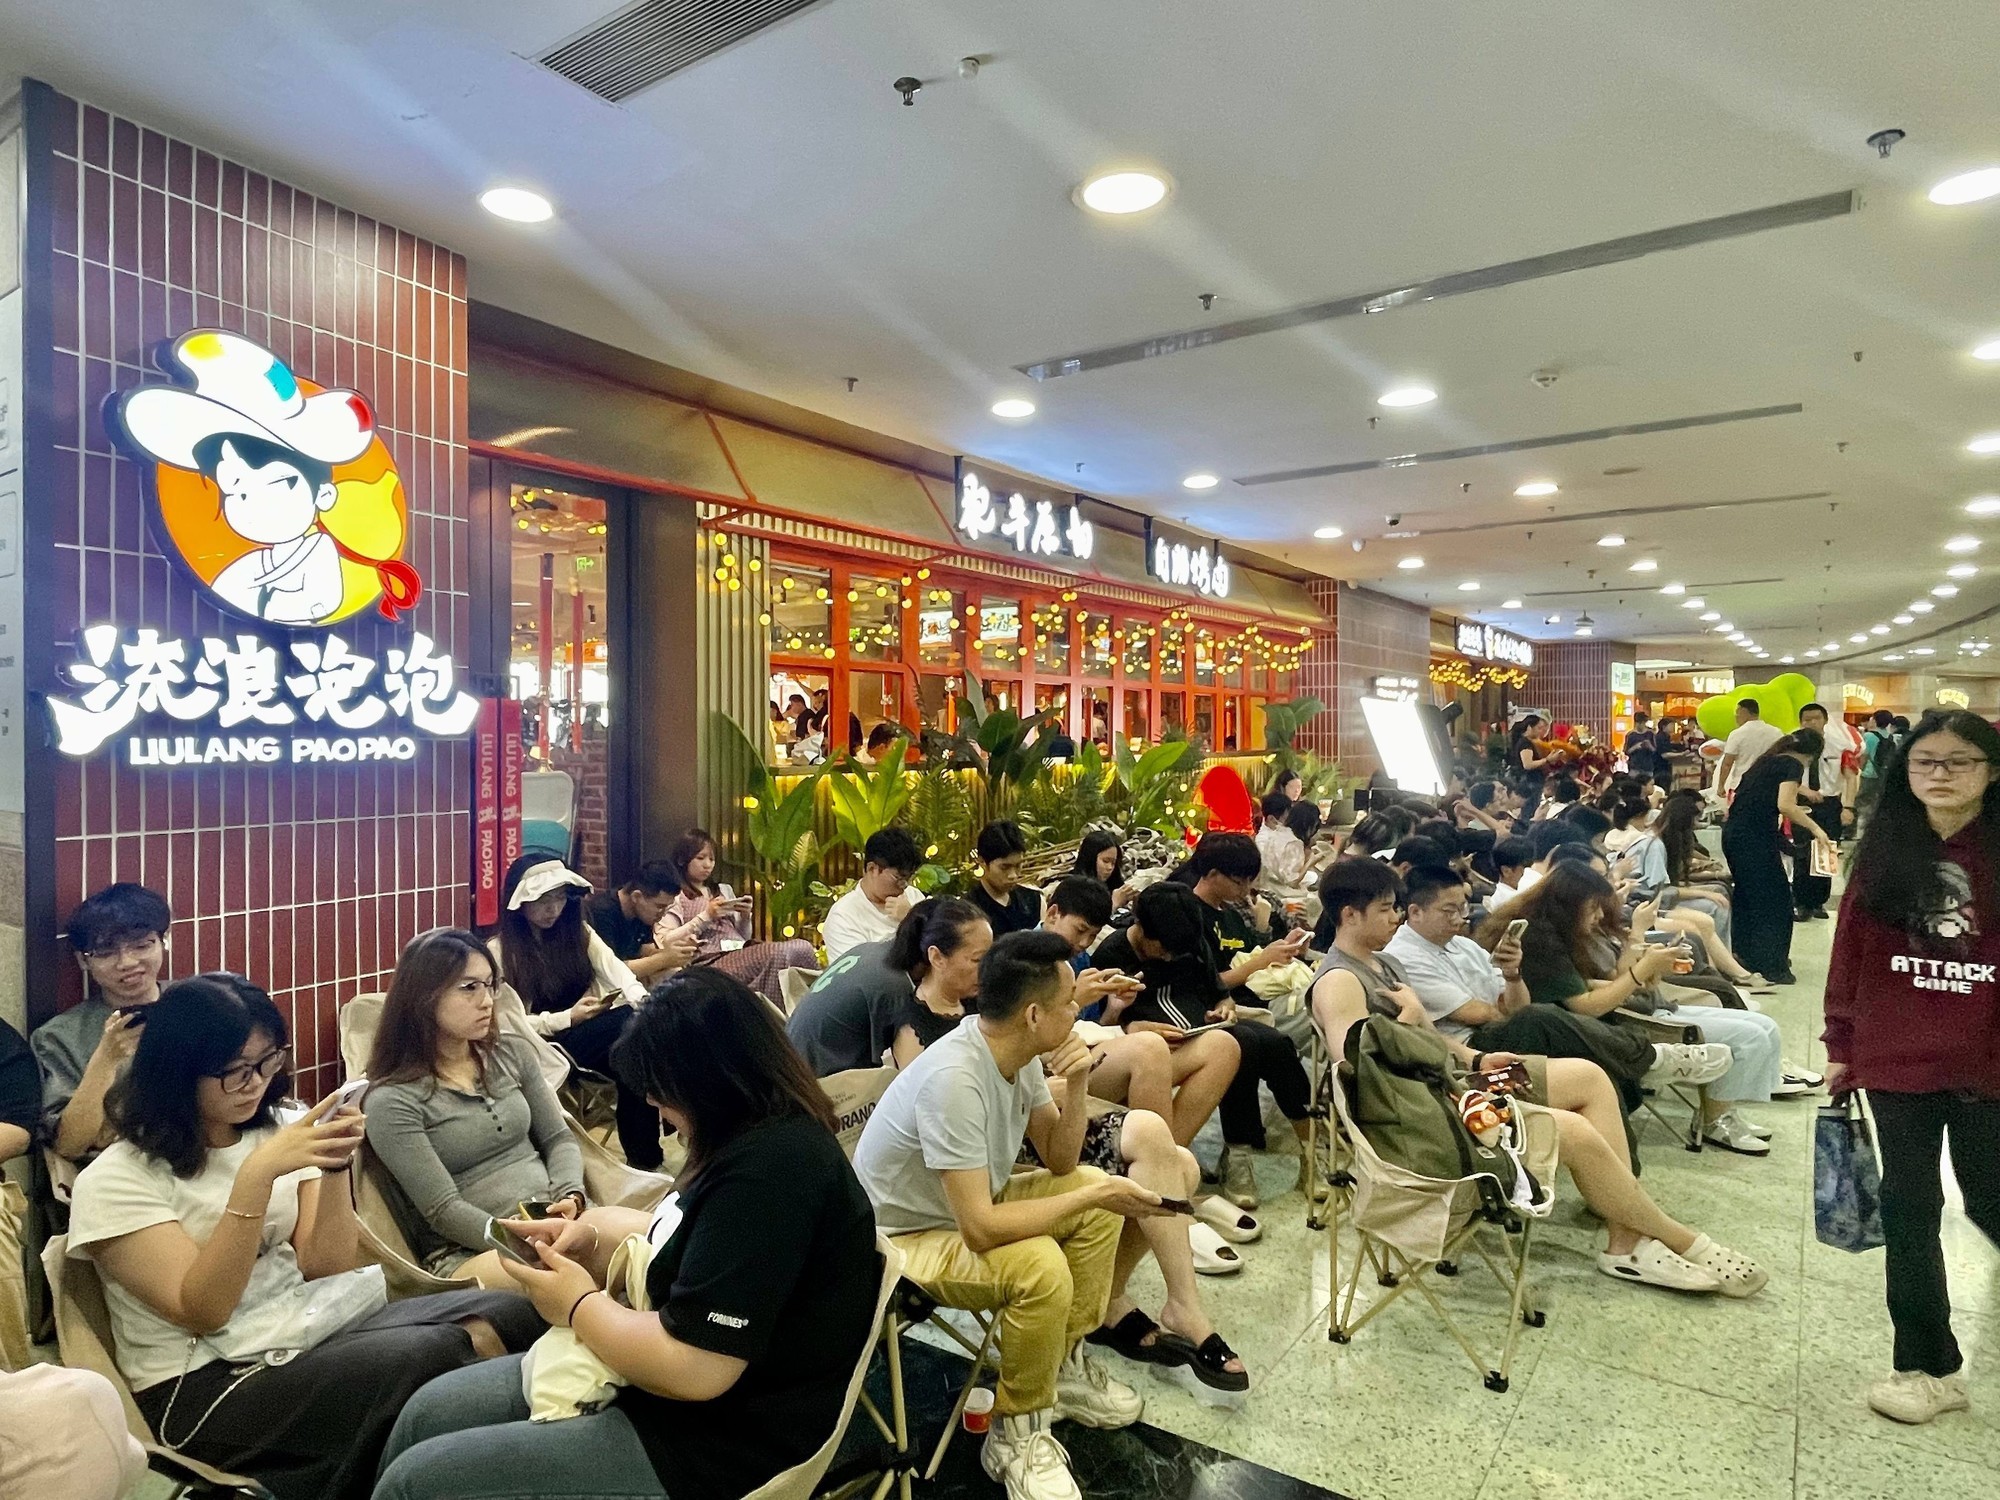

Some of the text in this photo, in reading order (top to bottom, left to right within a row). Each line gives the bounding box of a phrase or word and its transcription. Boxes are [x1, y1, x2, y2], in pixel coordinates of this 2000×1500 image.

[46, 624, 481, 756] 流浪泡泡
[129, 736, 416, 766] LIULANG PAOPAO
[481, 733, 493, 799] LIULANG
[505, 733, 517, 797] LIULANG
[481, 829, 494, 889] PAOPAO
[506, 827, 517, 869] PAO
[1891, 955, 1996, 983] ATTACK
[1913, 975, 1973, 995] GAME
